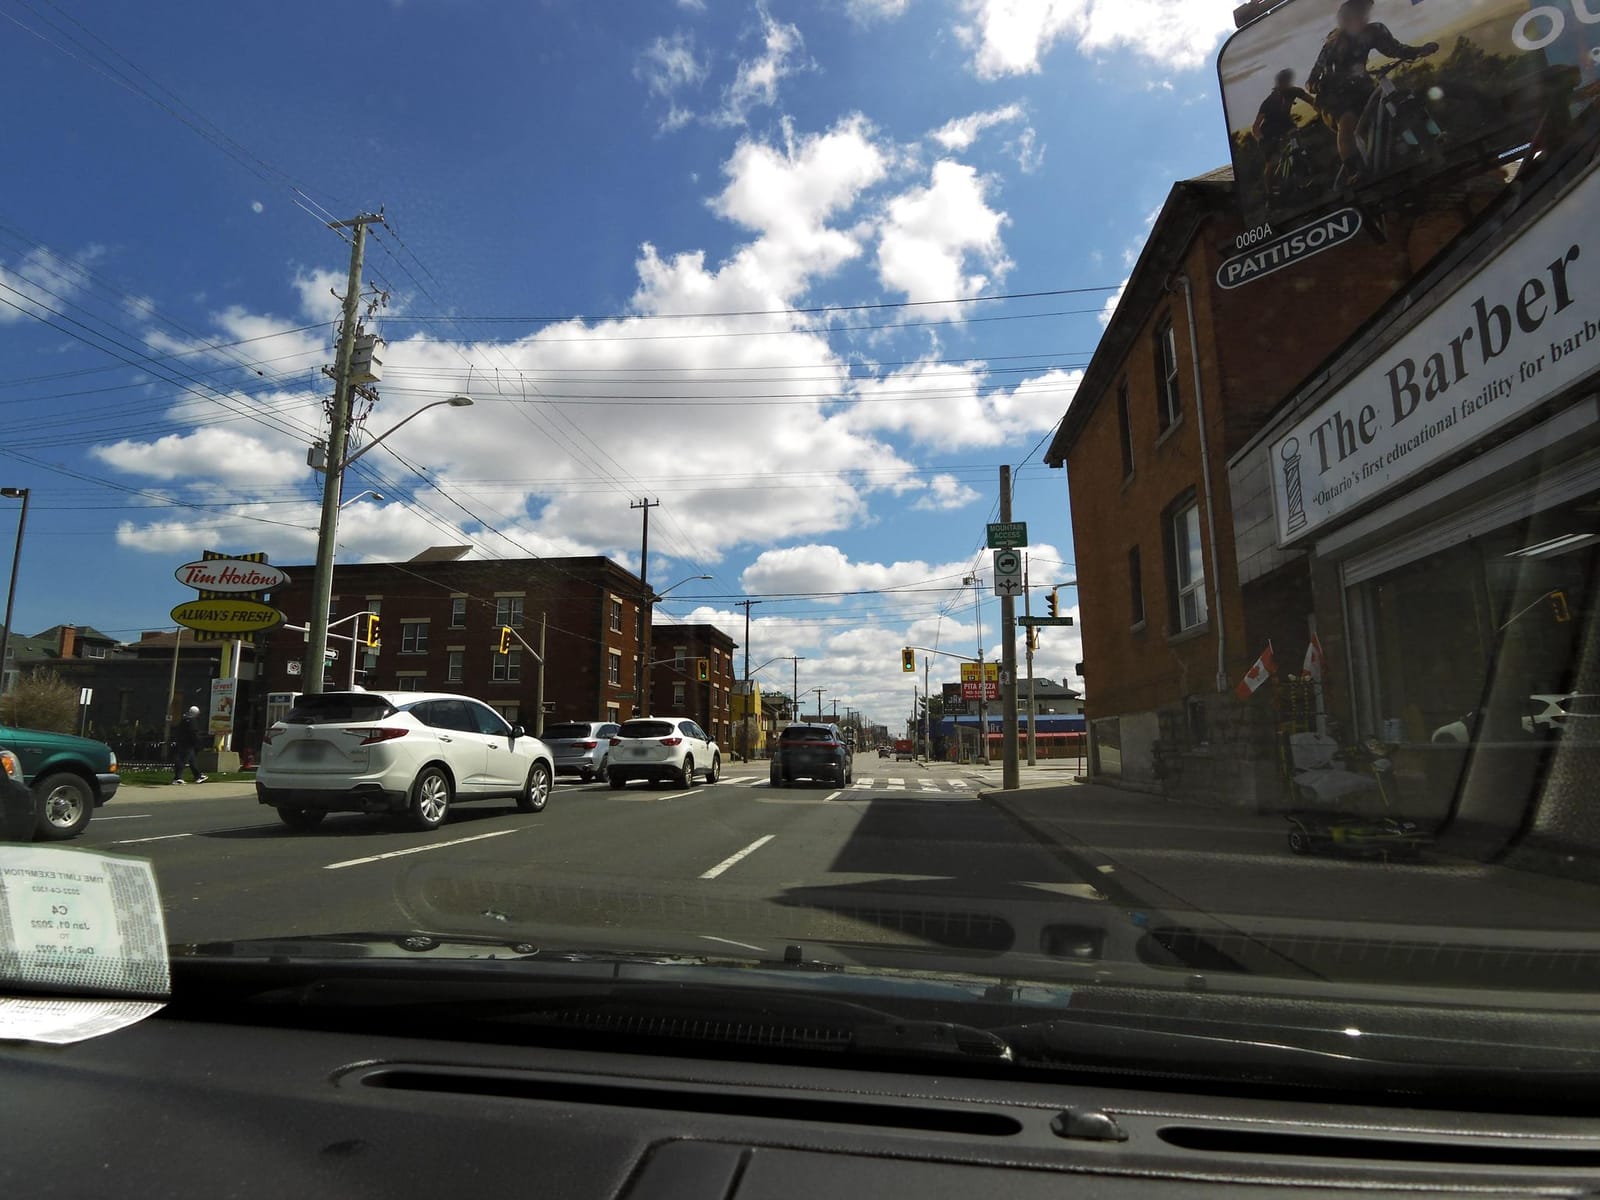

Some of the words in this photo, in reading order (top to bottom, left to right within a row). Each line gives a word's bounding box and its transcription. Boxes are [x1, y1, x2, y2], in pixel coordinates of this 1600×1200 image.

[1235, 222, 1273, 250] 0060A
[1226, 215, 1351, 283] PATTISON
[1309, 402, 1380, 477] The
[1384, 243, 1581, 428] Barber
[1362, 456, 1385, 479] first
[1386, 408, 1458, 465] educational
[1461, 373, 1515, 417] facility
[1520, 353, 1546, 384] for
[989, 523, 1025, 532] MOUNTAIN
[994, 531, 1021, 539] ACCESS
[185, 565, 216, 585] Tim
[218, 565, 277, 586] Hortons
[178, 608, 230, 622] ALWAYS
[231, 610, 274, 623] FRESH
